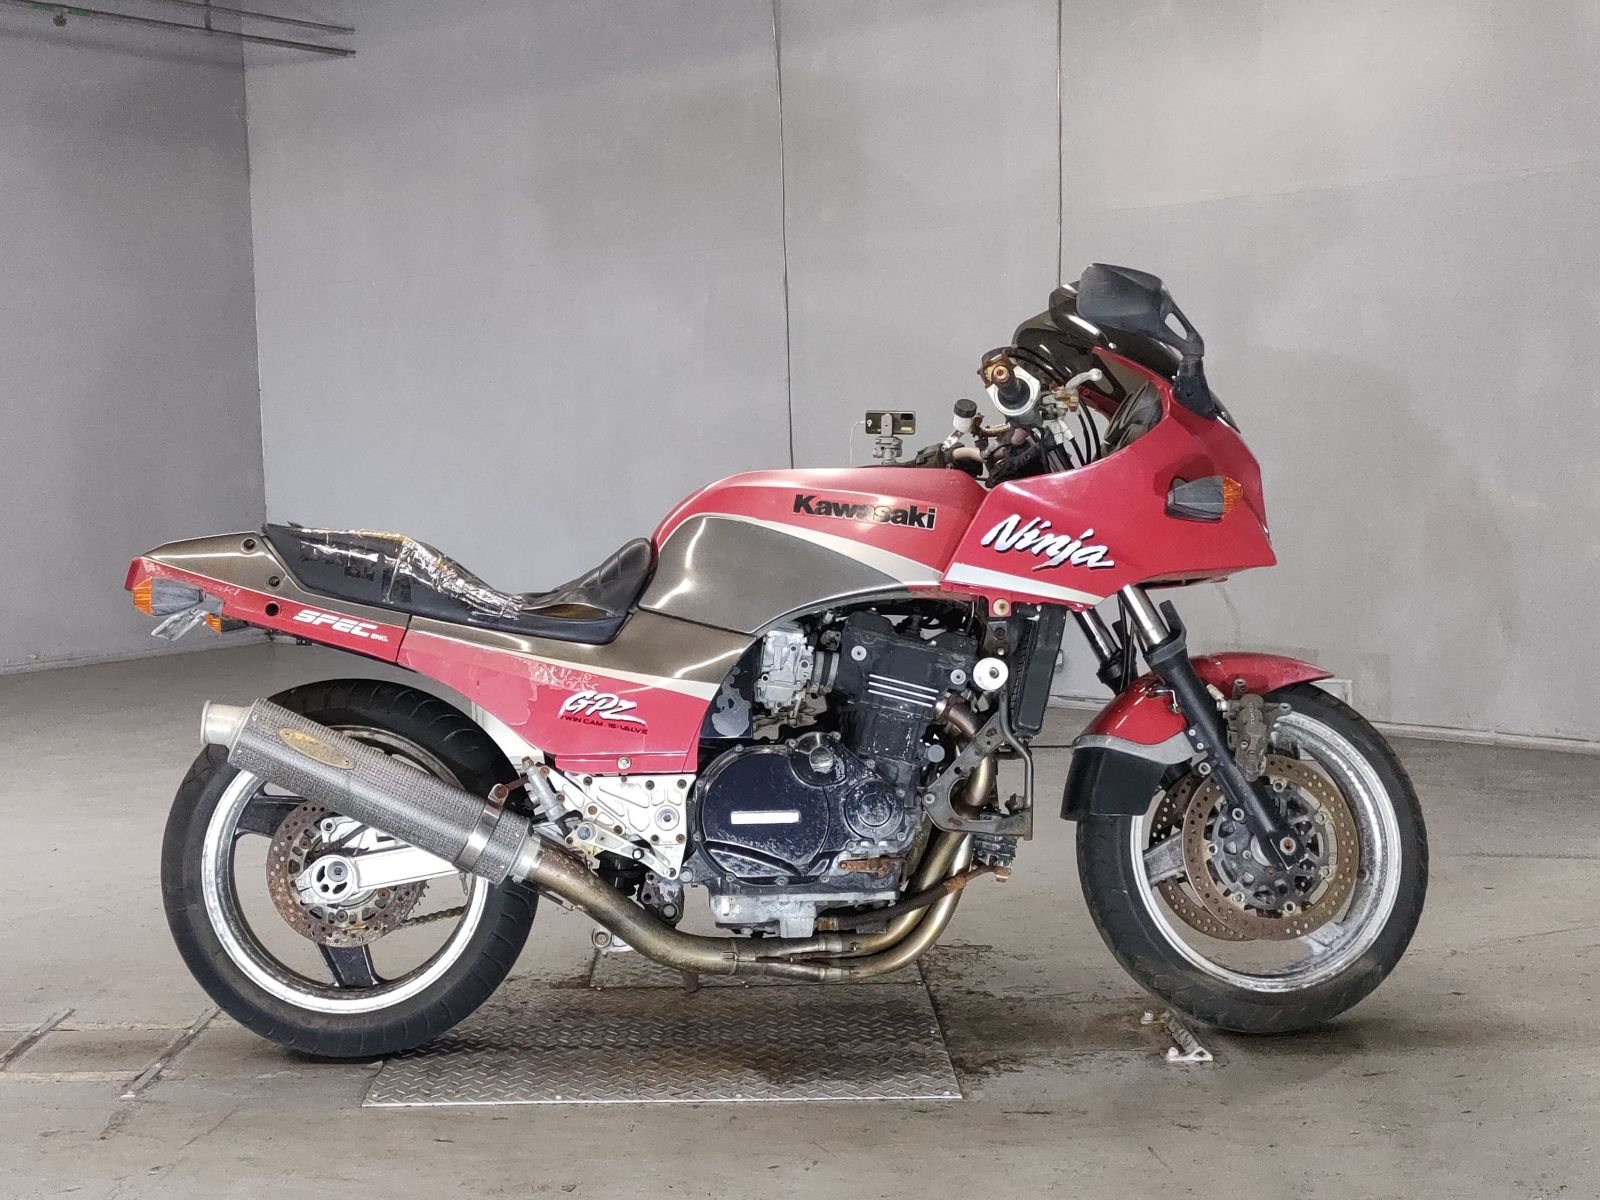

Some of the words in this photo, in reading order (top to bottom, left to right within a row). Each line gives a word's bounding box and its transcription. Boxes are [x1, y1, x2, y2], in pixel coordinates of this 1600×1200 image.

[793, 494, 936, 530] Kawasaki
[980, 513, 1116, 572] Ninja
[292, 609, 378, 638] SPEC
[583, 718, 603, 727] CAM
